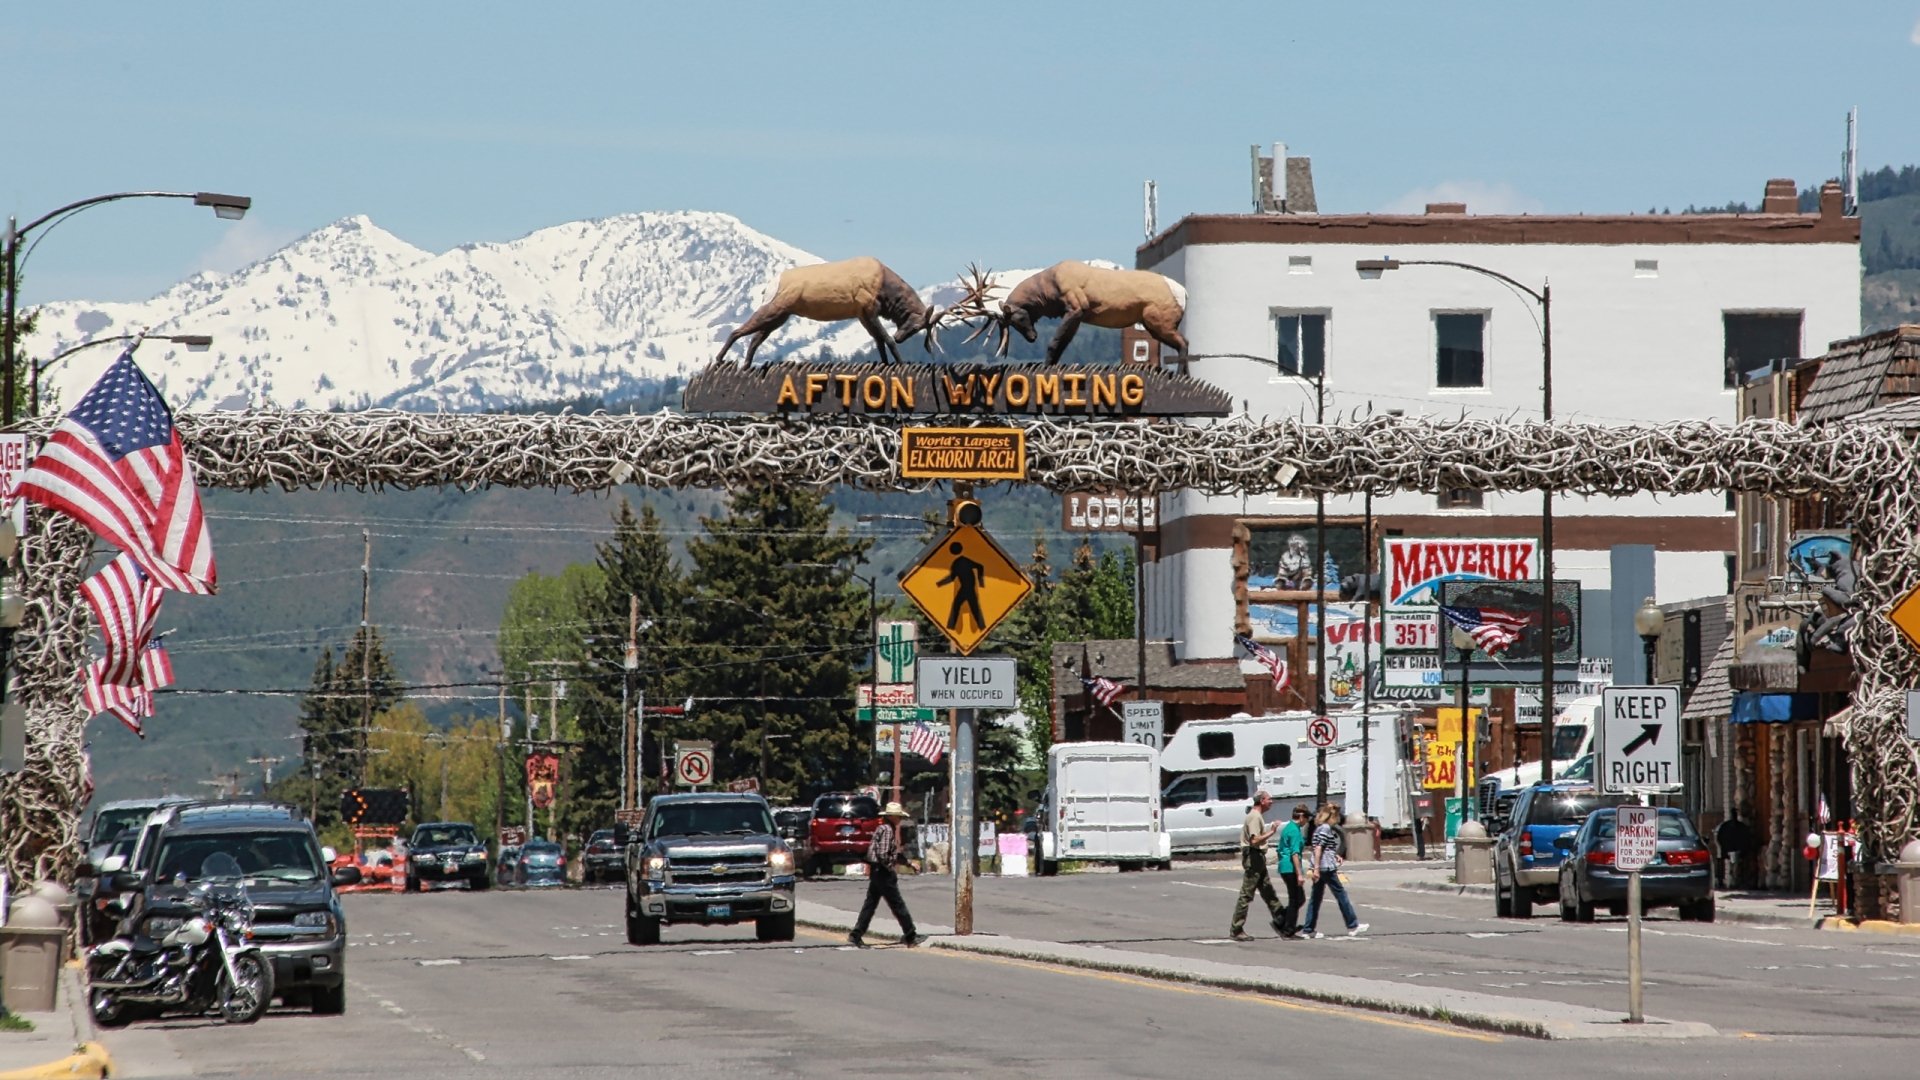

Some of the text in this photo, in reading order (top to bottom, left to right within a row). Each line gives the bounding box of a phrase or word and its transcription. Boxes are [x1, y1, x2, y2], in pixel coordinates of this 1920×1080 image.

[777, 373, 1144, 408] AFTON WYOMING
[916, 436, 1010, 448] World's Largest
[910, 450, 1016, 468] ELKHORN ARCH
[1390, 543, 1534, 607] MAVERIK
[1386, 657, 1406, 669] NEW
[942, 667, 992, 685] YIELD
[931, 690, 1004, 699] WHEN OCCUPIED
[1127, 708, 1160, 717] SPEED
[1615, 696, 1667, 719] KEEP
[1131, 721, 1155, 729] LIMIT
[1612, 761, 1671, 784] RIGHT
[1630, 812, 1645, 824] NO
[1619, 825, 1655, 837] PARKING
[1620, 848, 1653, 857] FOR SNOW
[1622, 857, 1651, 865] REMOVA
